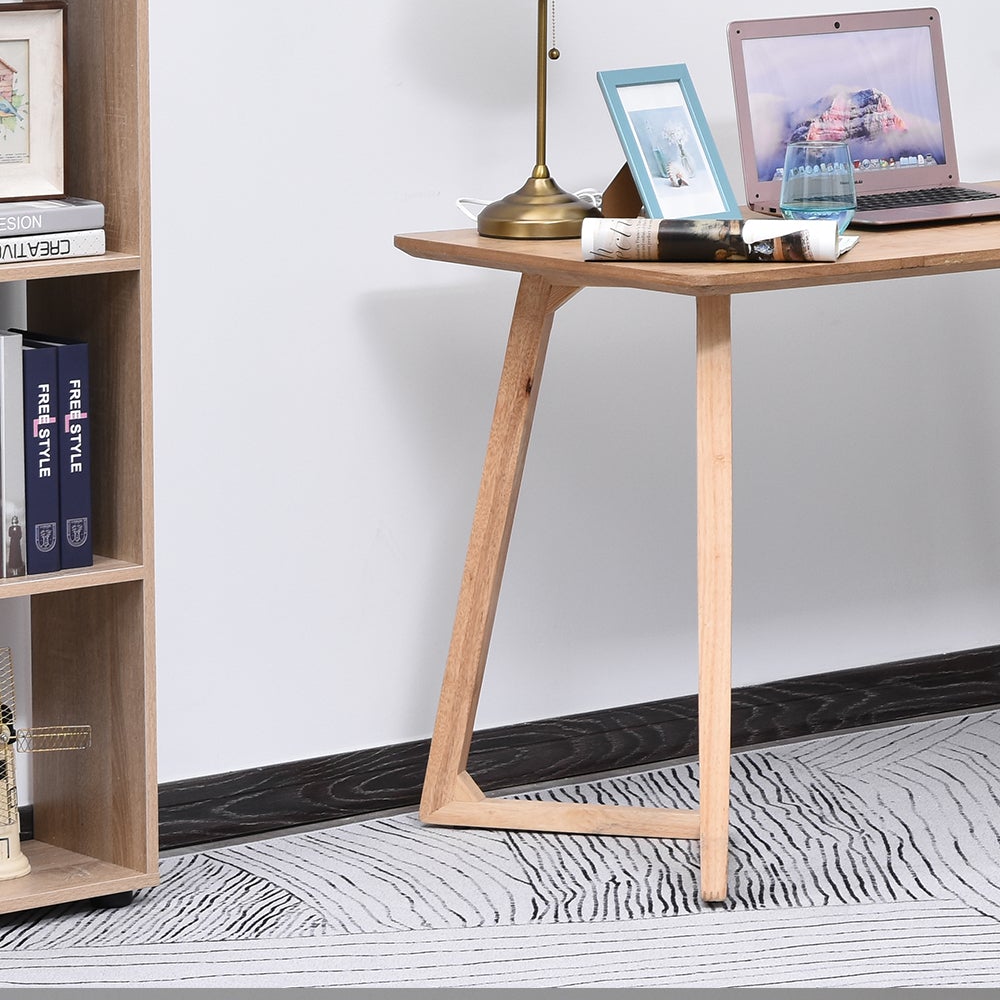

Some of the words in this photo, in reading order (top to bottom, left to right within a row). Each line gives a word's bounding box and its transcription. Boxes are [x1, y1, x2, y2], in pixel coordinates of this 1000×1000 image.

[0, 239, 70, 259] CREATIV
[38, 383, 50, 424] FREE
[69, 379, 82, 419] FREE
[39, 428, 51, 478] STYLE
[70, 424, 82, 473] STYLE
